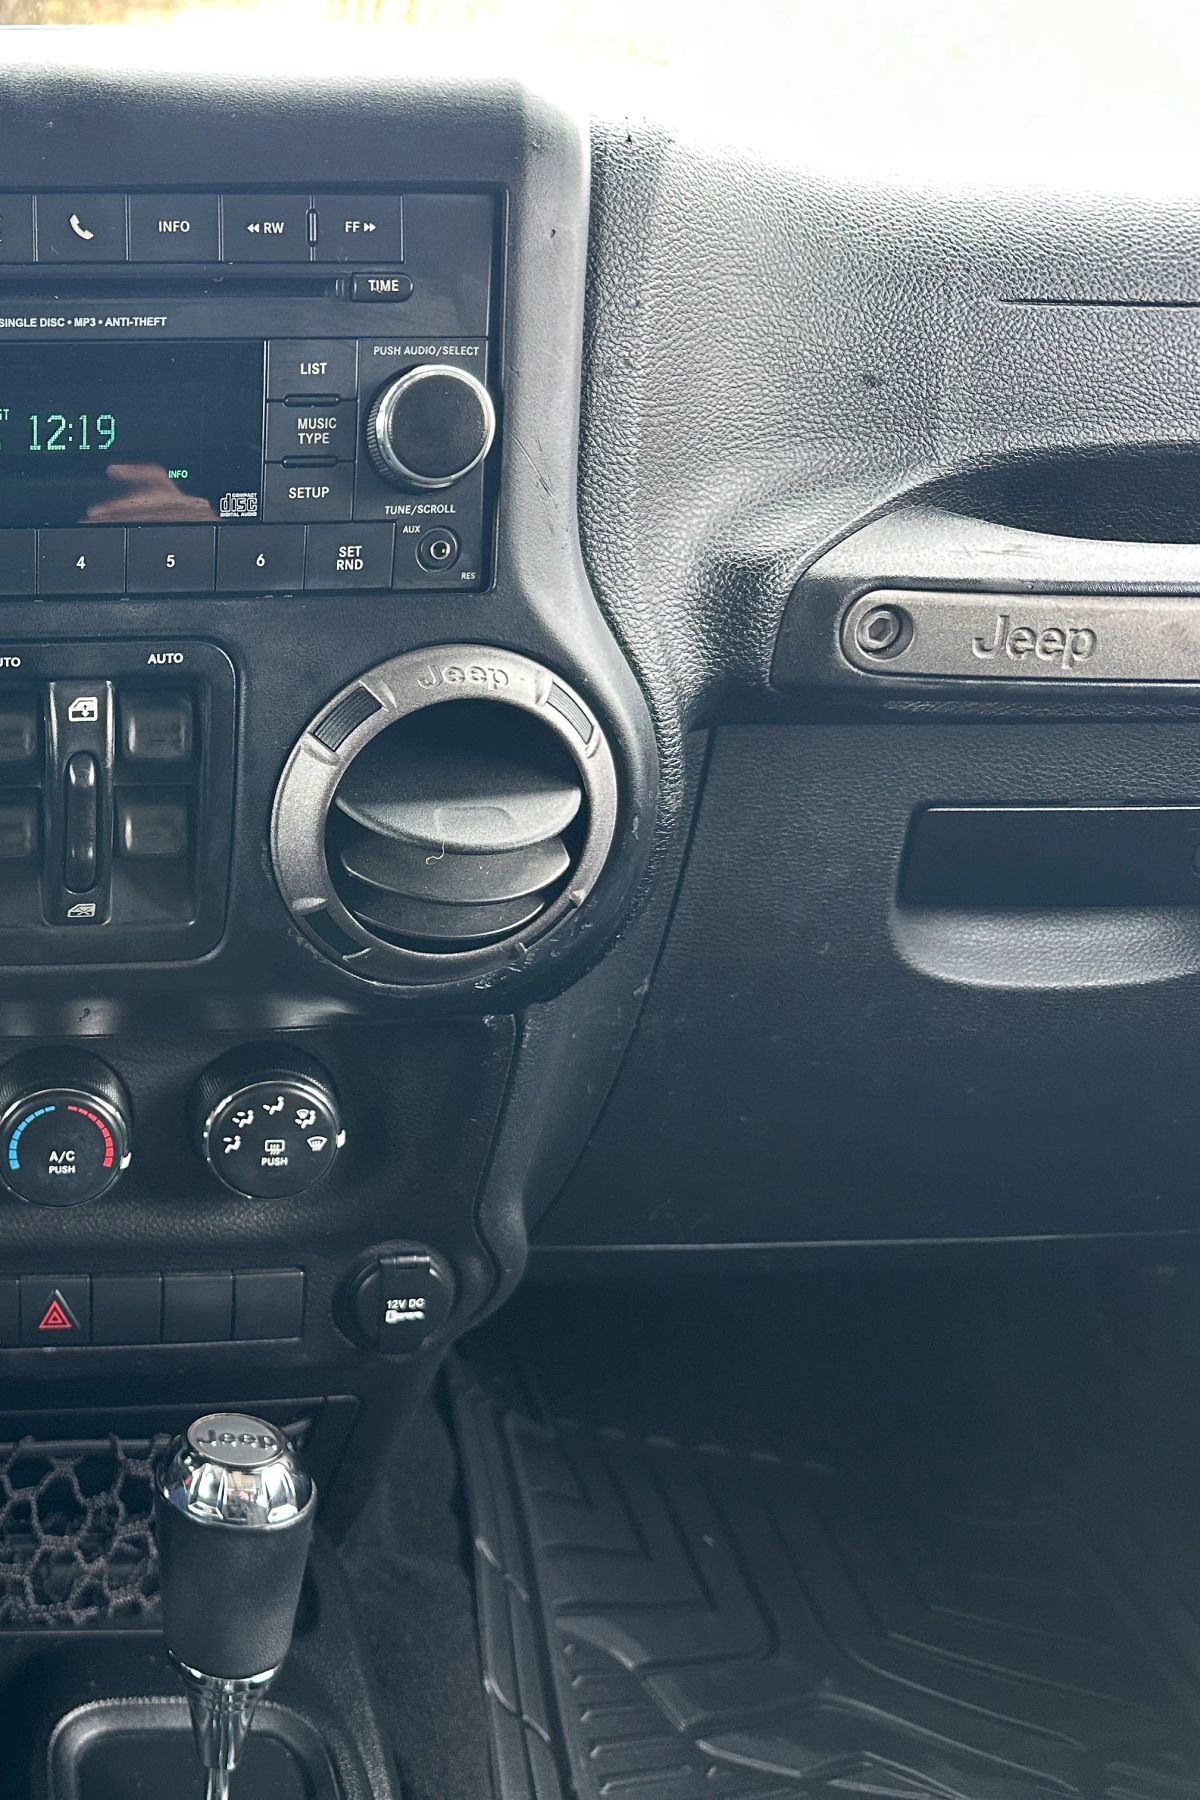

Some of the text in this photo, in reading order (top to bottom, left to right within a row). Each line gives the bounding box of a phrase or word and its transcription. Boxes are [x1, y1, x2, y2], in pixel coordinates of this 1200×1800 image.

[158, 220, 191, 233] INFO
[263, 221, 285, 234] RW
[345, 221, 360, 233] FF
[367, 279, 400, 294] TIME
[39, 317, 66, 328] DISC
[73, 317, 97, 327] MP3
[104, 316, 168, 327] ANTI-THEFT
[373, 345, 480, 357] PUSH AUDIO/SELECT
[300, 362, 328, 375] LIST
[297, 417, 337, 430] MUSIC
[29, 414, 116, 451] 12:19
[297, 432, 330, 445] TYPE
[168, 469, 189, 479] INFO
[288, 486, 330, 499] SETUP
[384, 504, 456, 516] TUNE/SCROLL
[402, 525, 421, 534] AUX
[338, 545, 363, 558] SET
[76, 555, 86, 570] 4
[166, 554, 176, 568] 5
[256, 553, 266, 567] 6
[336, 558, 364, 571] RND
[460, 571, 476, 580] RES
[971, 614, 1098, 670] Jeep
[147, 652, 184, 665] AUTO
[416, 664, 510, 691] Jeep
[48, 1150, 76, 1164] A/C
[260, 1156, 289, 1167] PUSH
[48, 1165, 76, 1174] PUSH
[386, 1297, 426, 1310] 12V DC
[197, 1429, 278, 1451] Jeep
